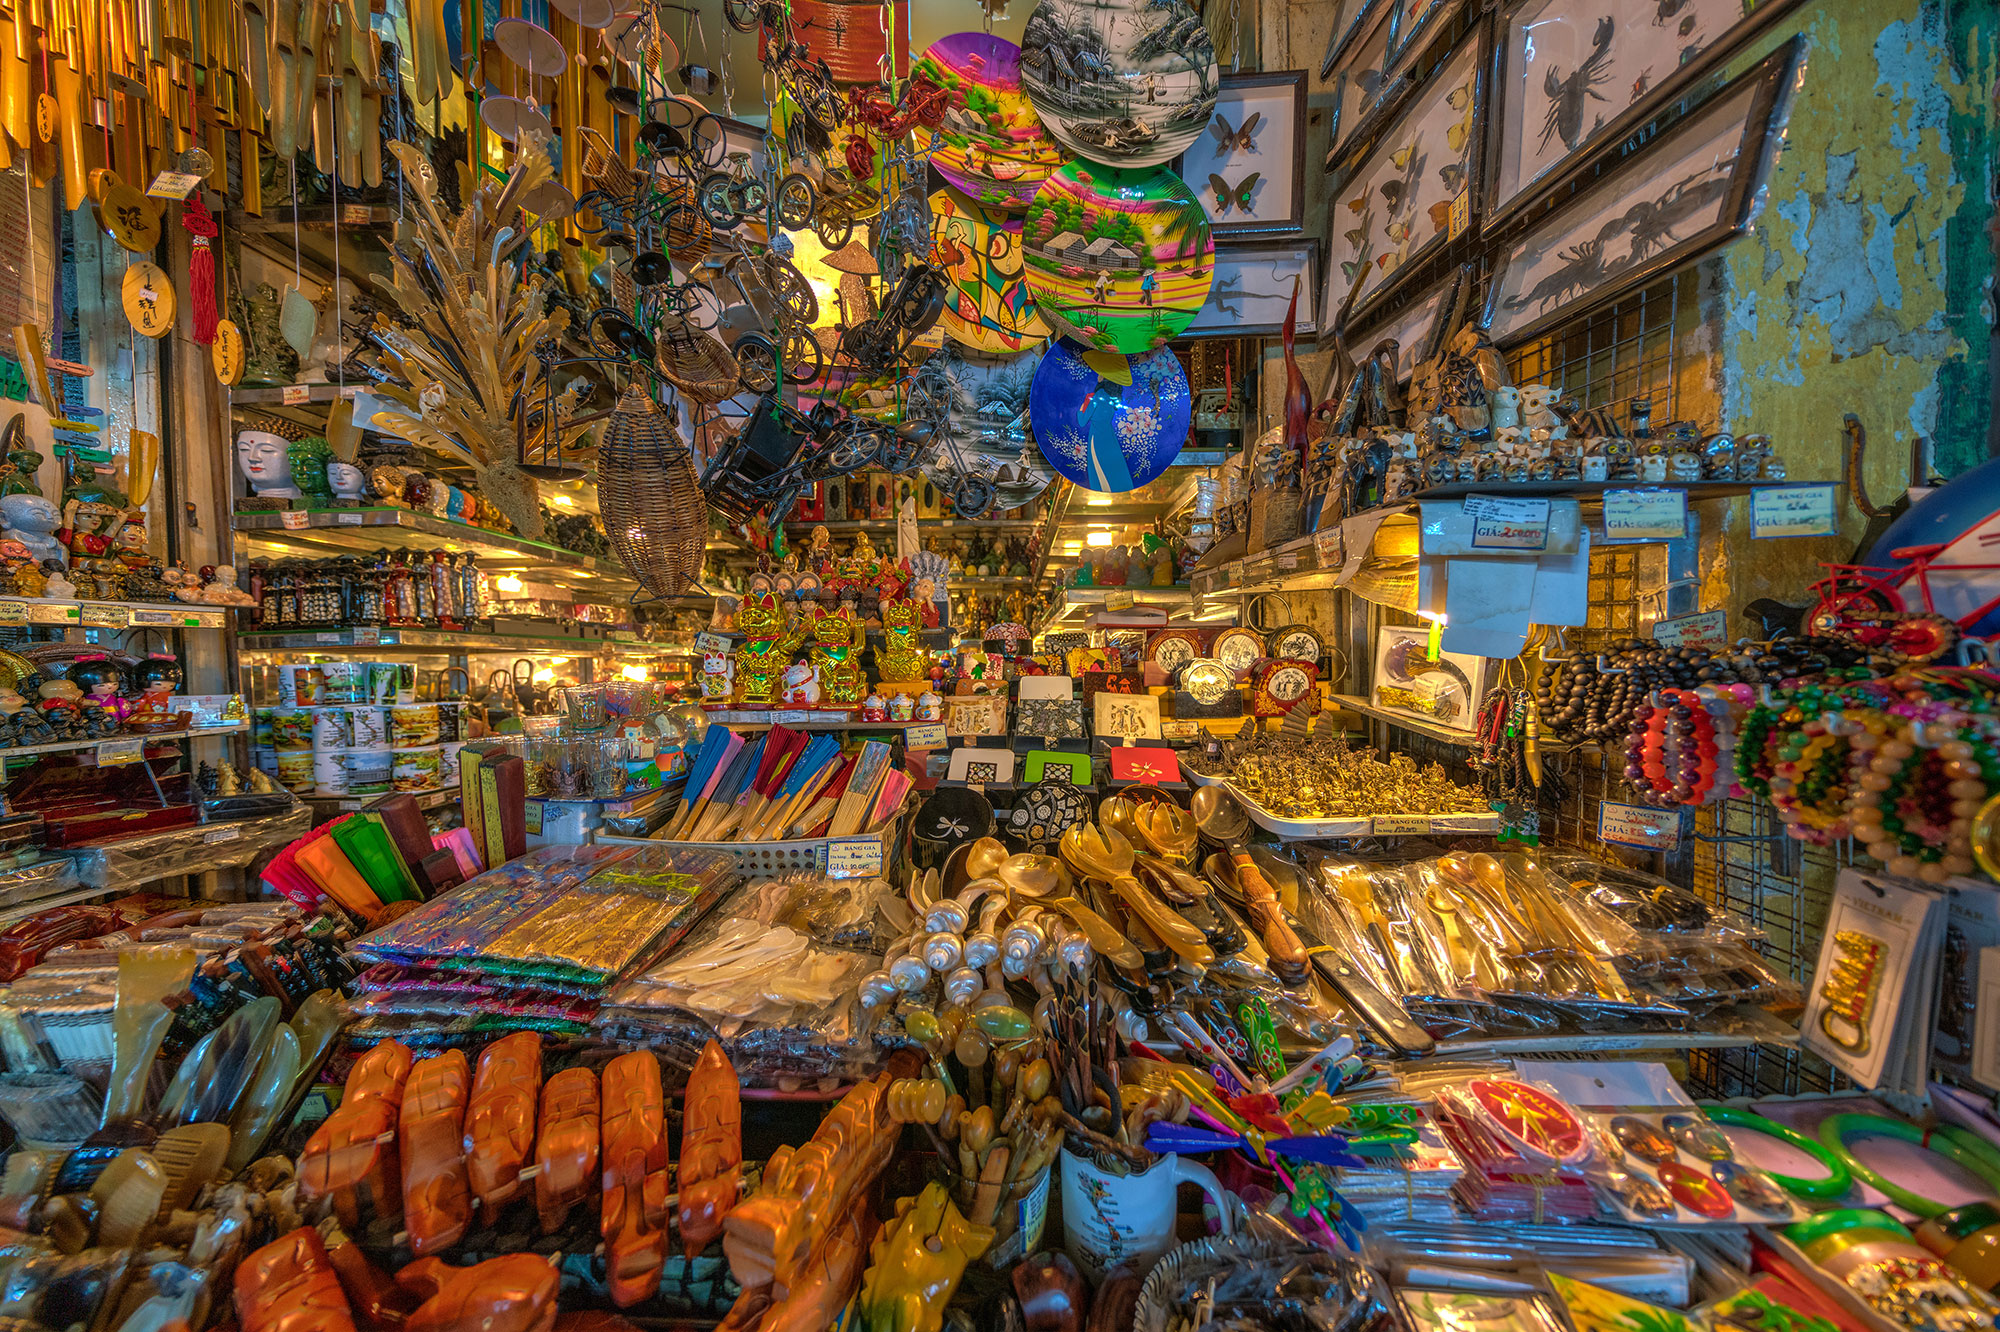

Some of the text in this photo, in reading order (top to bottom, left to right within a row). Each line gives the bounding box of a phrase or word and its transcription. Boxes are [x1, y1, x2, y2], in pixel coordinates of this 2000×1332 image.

[1477, 525, 1501, 537] GIÁ:
[1604, 824, 1629, 835] GIÁ:
[830, 861, 848, 870] GIÁ:
